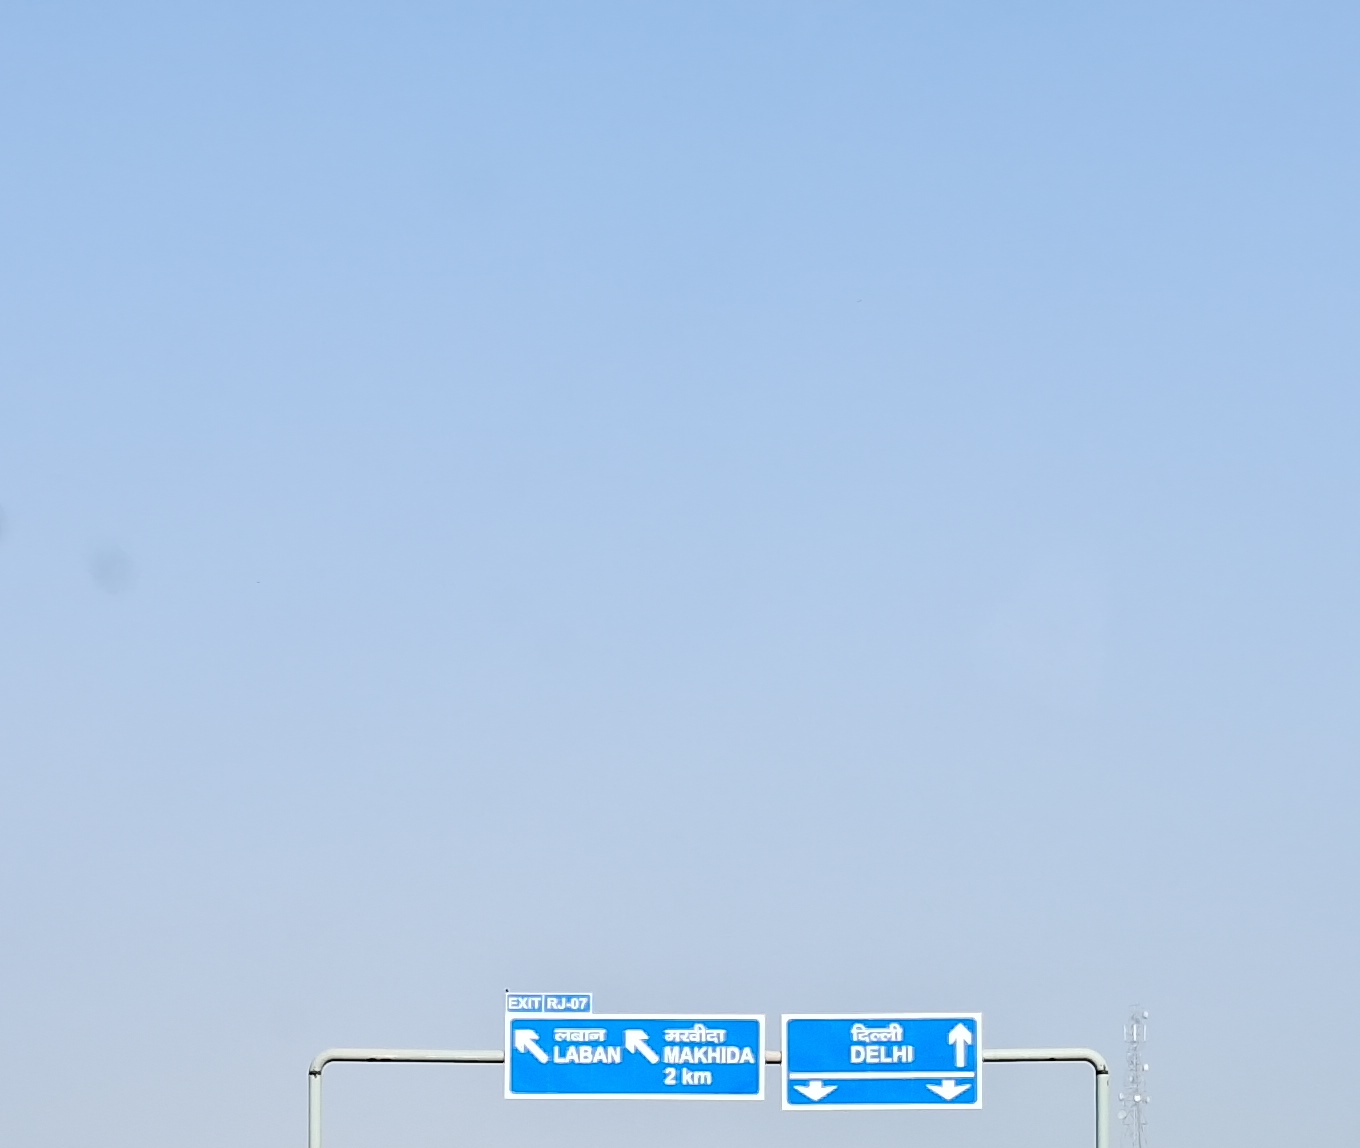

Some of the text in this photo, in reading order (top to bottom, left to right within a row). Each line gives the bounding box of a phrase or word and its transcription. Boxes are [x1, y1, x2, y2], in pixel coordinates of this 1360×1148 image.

[508, 997, 588, 1010] EXIT RJ-07
[553, 1028, 607, 1042] लबान
[850, 1023, 903, 1043] दिल्ली
[553, 1046, 622, 1064] LABAN
[663, 1046, 755, 1064] MAKHIDA
[850, 1045, 915, 1064] DELHI
[664, 1068, 712, 1085] 2 km
